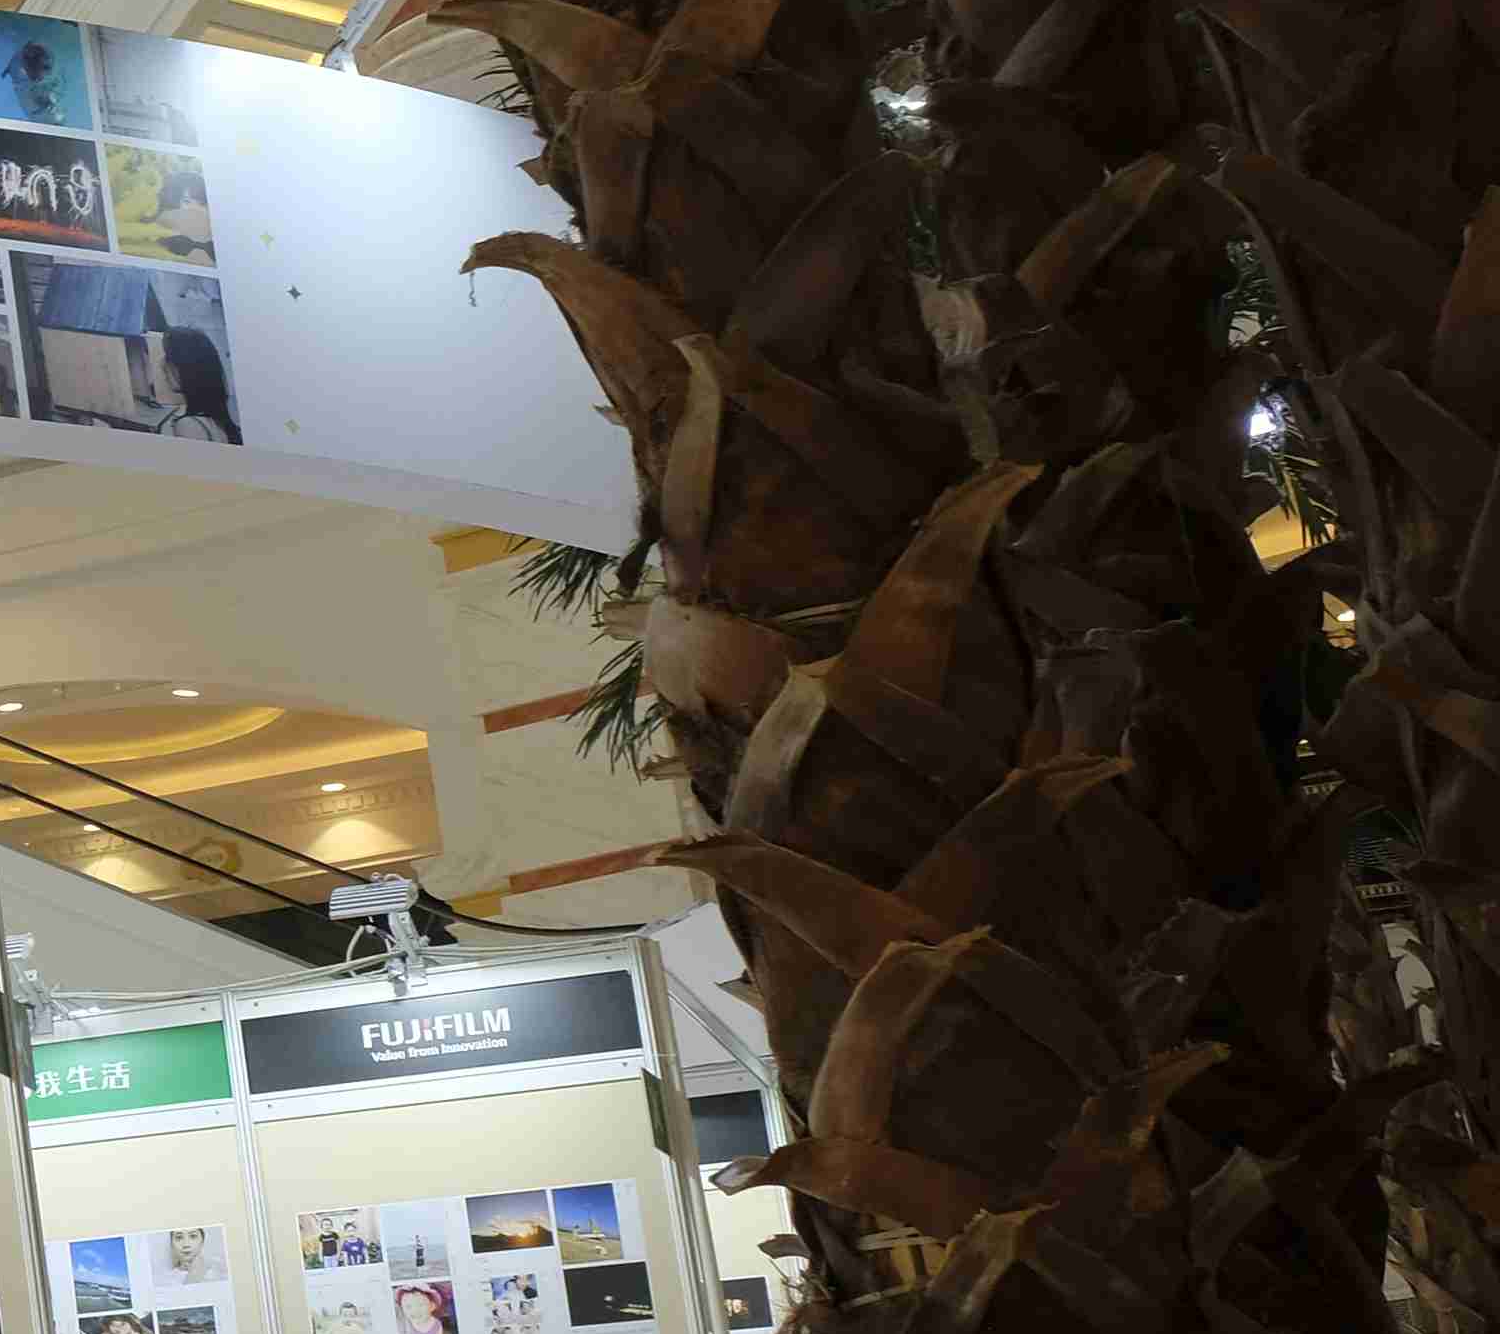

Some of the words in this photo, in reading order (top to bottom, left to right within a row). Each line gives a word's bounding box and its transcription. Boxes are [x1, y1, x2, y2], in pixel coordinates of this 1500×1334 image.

[361, 1007, 511, 1049] FUJIFILM
[371, 1049, 406, 1064] Value
[408, 1045, 440, 1059] from
[441, 1036, 508, 1054] Innovation
